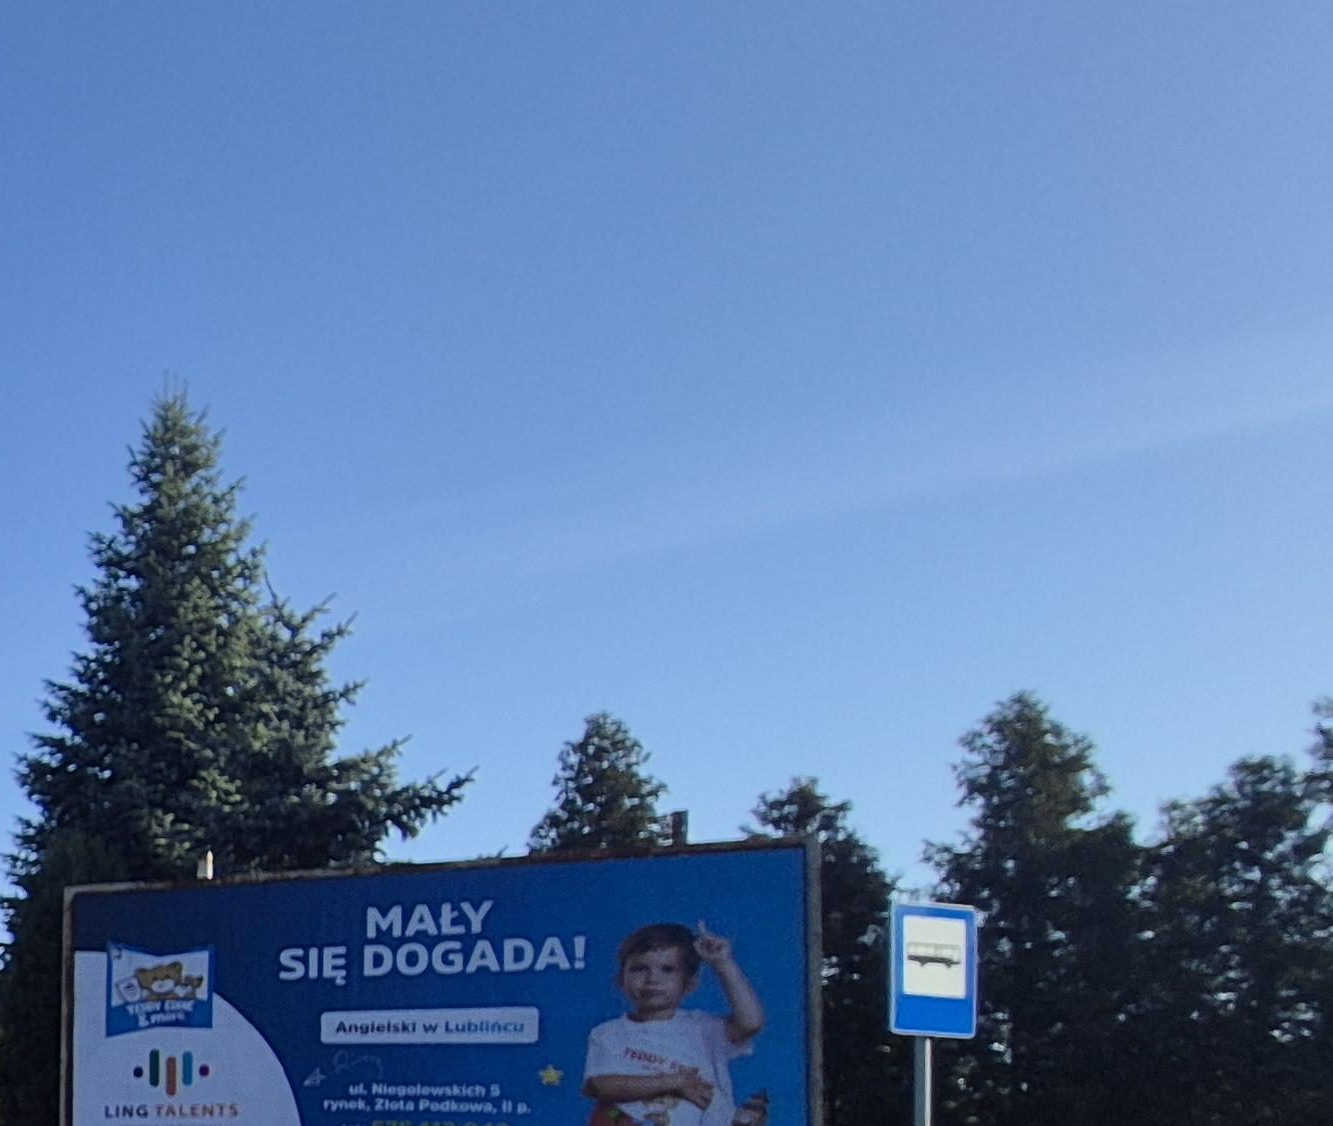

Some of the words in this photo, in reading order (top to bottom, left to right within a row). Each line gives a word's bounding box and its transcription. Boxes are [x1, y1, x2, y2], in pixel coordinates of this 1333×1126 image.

[366, 900, 493, 939] MAŁY
[279, 946, 347, 986] SIĘ
[363, 935, 586, 977] DOGADA!
[336, 1020, 416, 1036] Angielski
[422, 1023, 438, 1033] w
[444, 1019, 525, 1034] Lublińcu
[348, 1083, 367, 1096] ul.
[372, 1082, 486, 1099] Niegolewskich
[104, 1104, 149, 1119] LING
[155, 1103, 239, 1119] TALENTS
[323, 1098, 371, 1112] rynek,
[374, 1098, 415, 1112] Złota
[419, 1099, 498, 1114] Podkowa,
